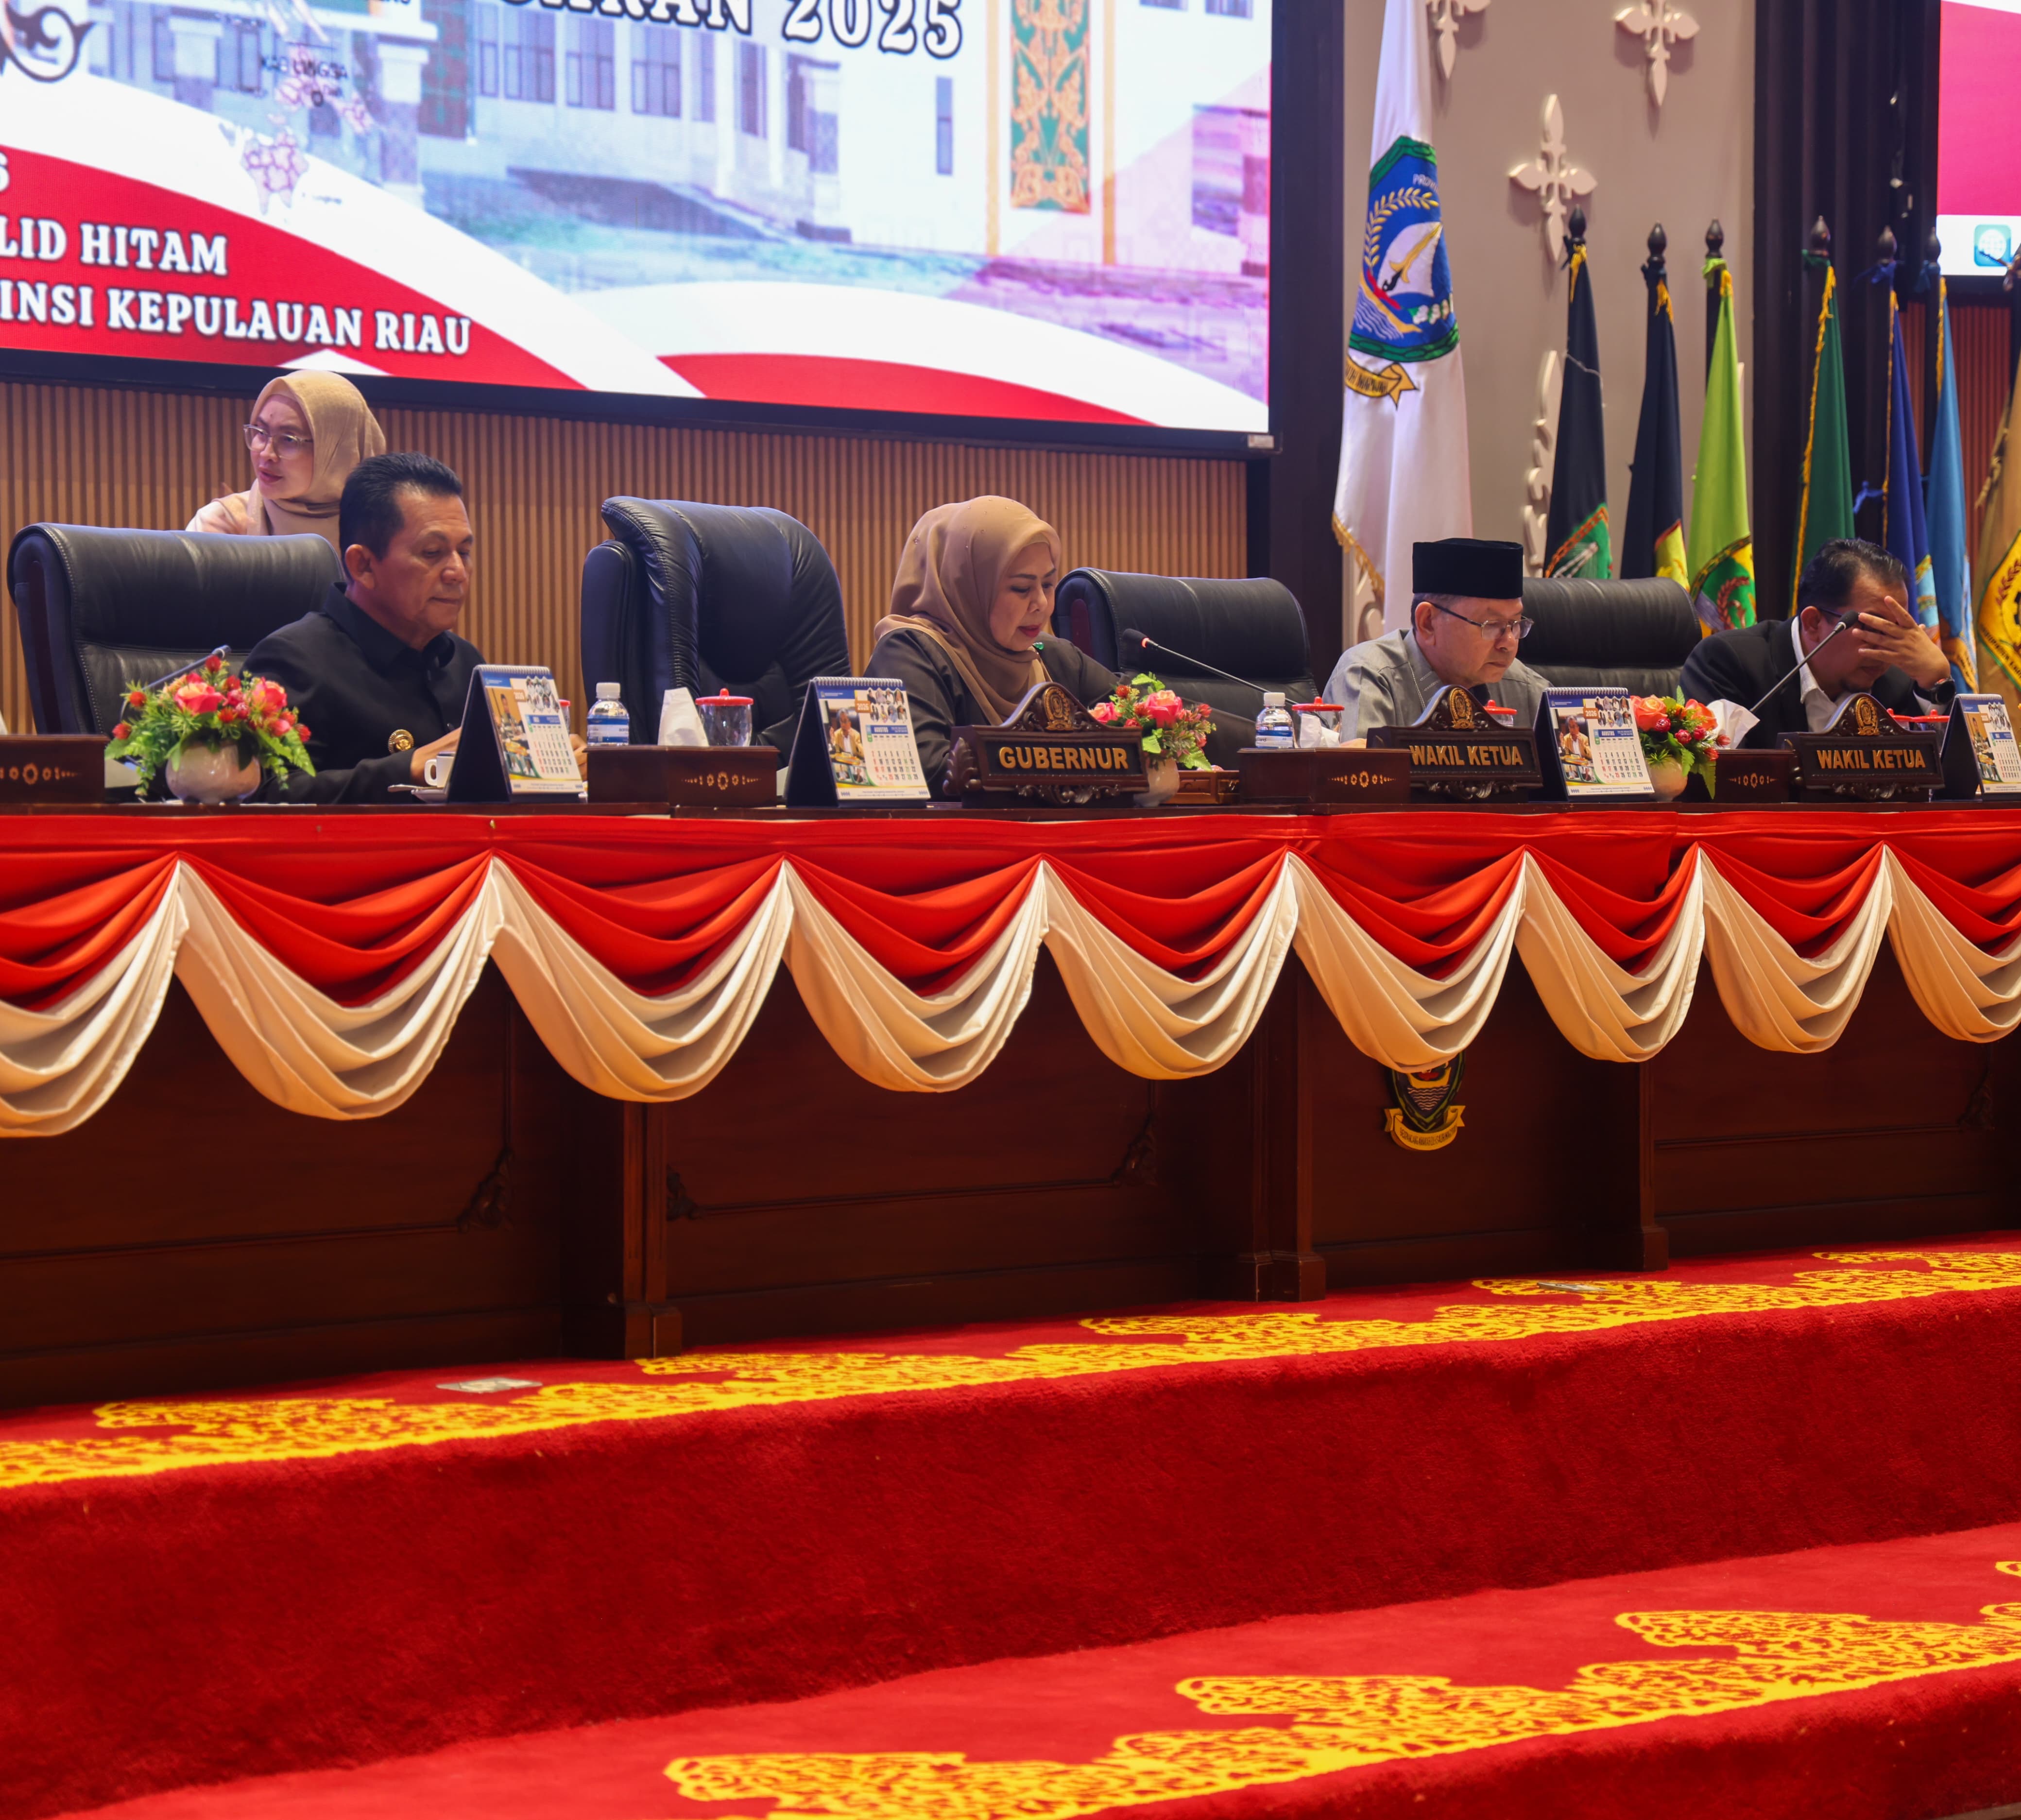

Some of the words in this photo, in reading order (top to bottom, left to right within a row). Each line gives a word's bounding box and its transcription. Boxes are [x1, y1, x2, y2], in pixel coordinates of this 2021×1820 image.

[782, 0, 961, 59] 2025
[80, 222, 228, 276] HITAM
[0, 279, 94, 327] INSI
[107, 288, 363, 348] KEPULAUAN
[375, 310, 471, 356] RIAU
[999, 747, 1128, 769] GUBERNUR
[1409, 745, 1465, 766] WAKIL
[1467, 745, 1524, 766] KETUA
[1816, 750, 1869, 769] WAKIL
[1872, 749, 1926, 769] KETUA
